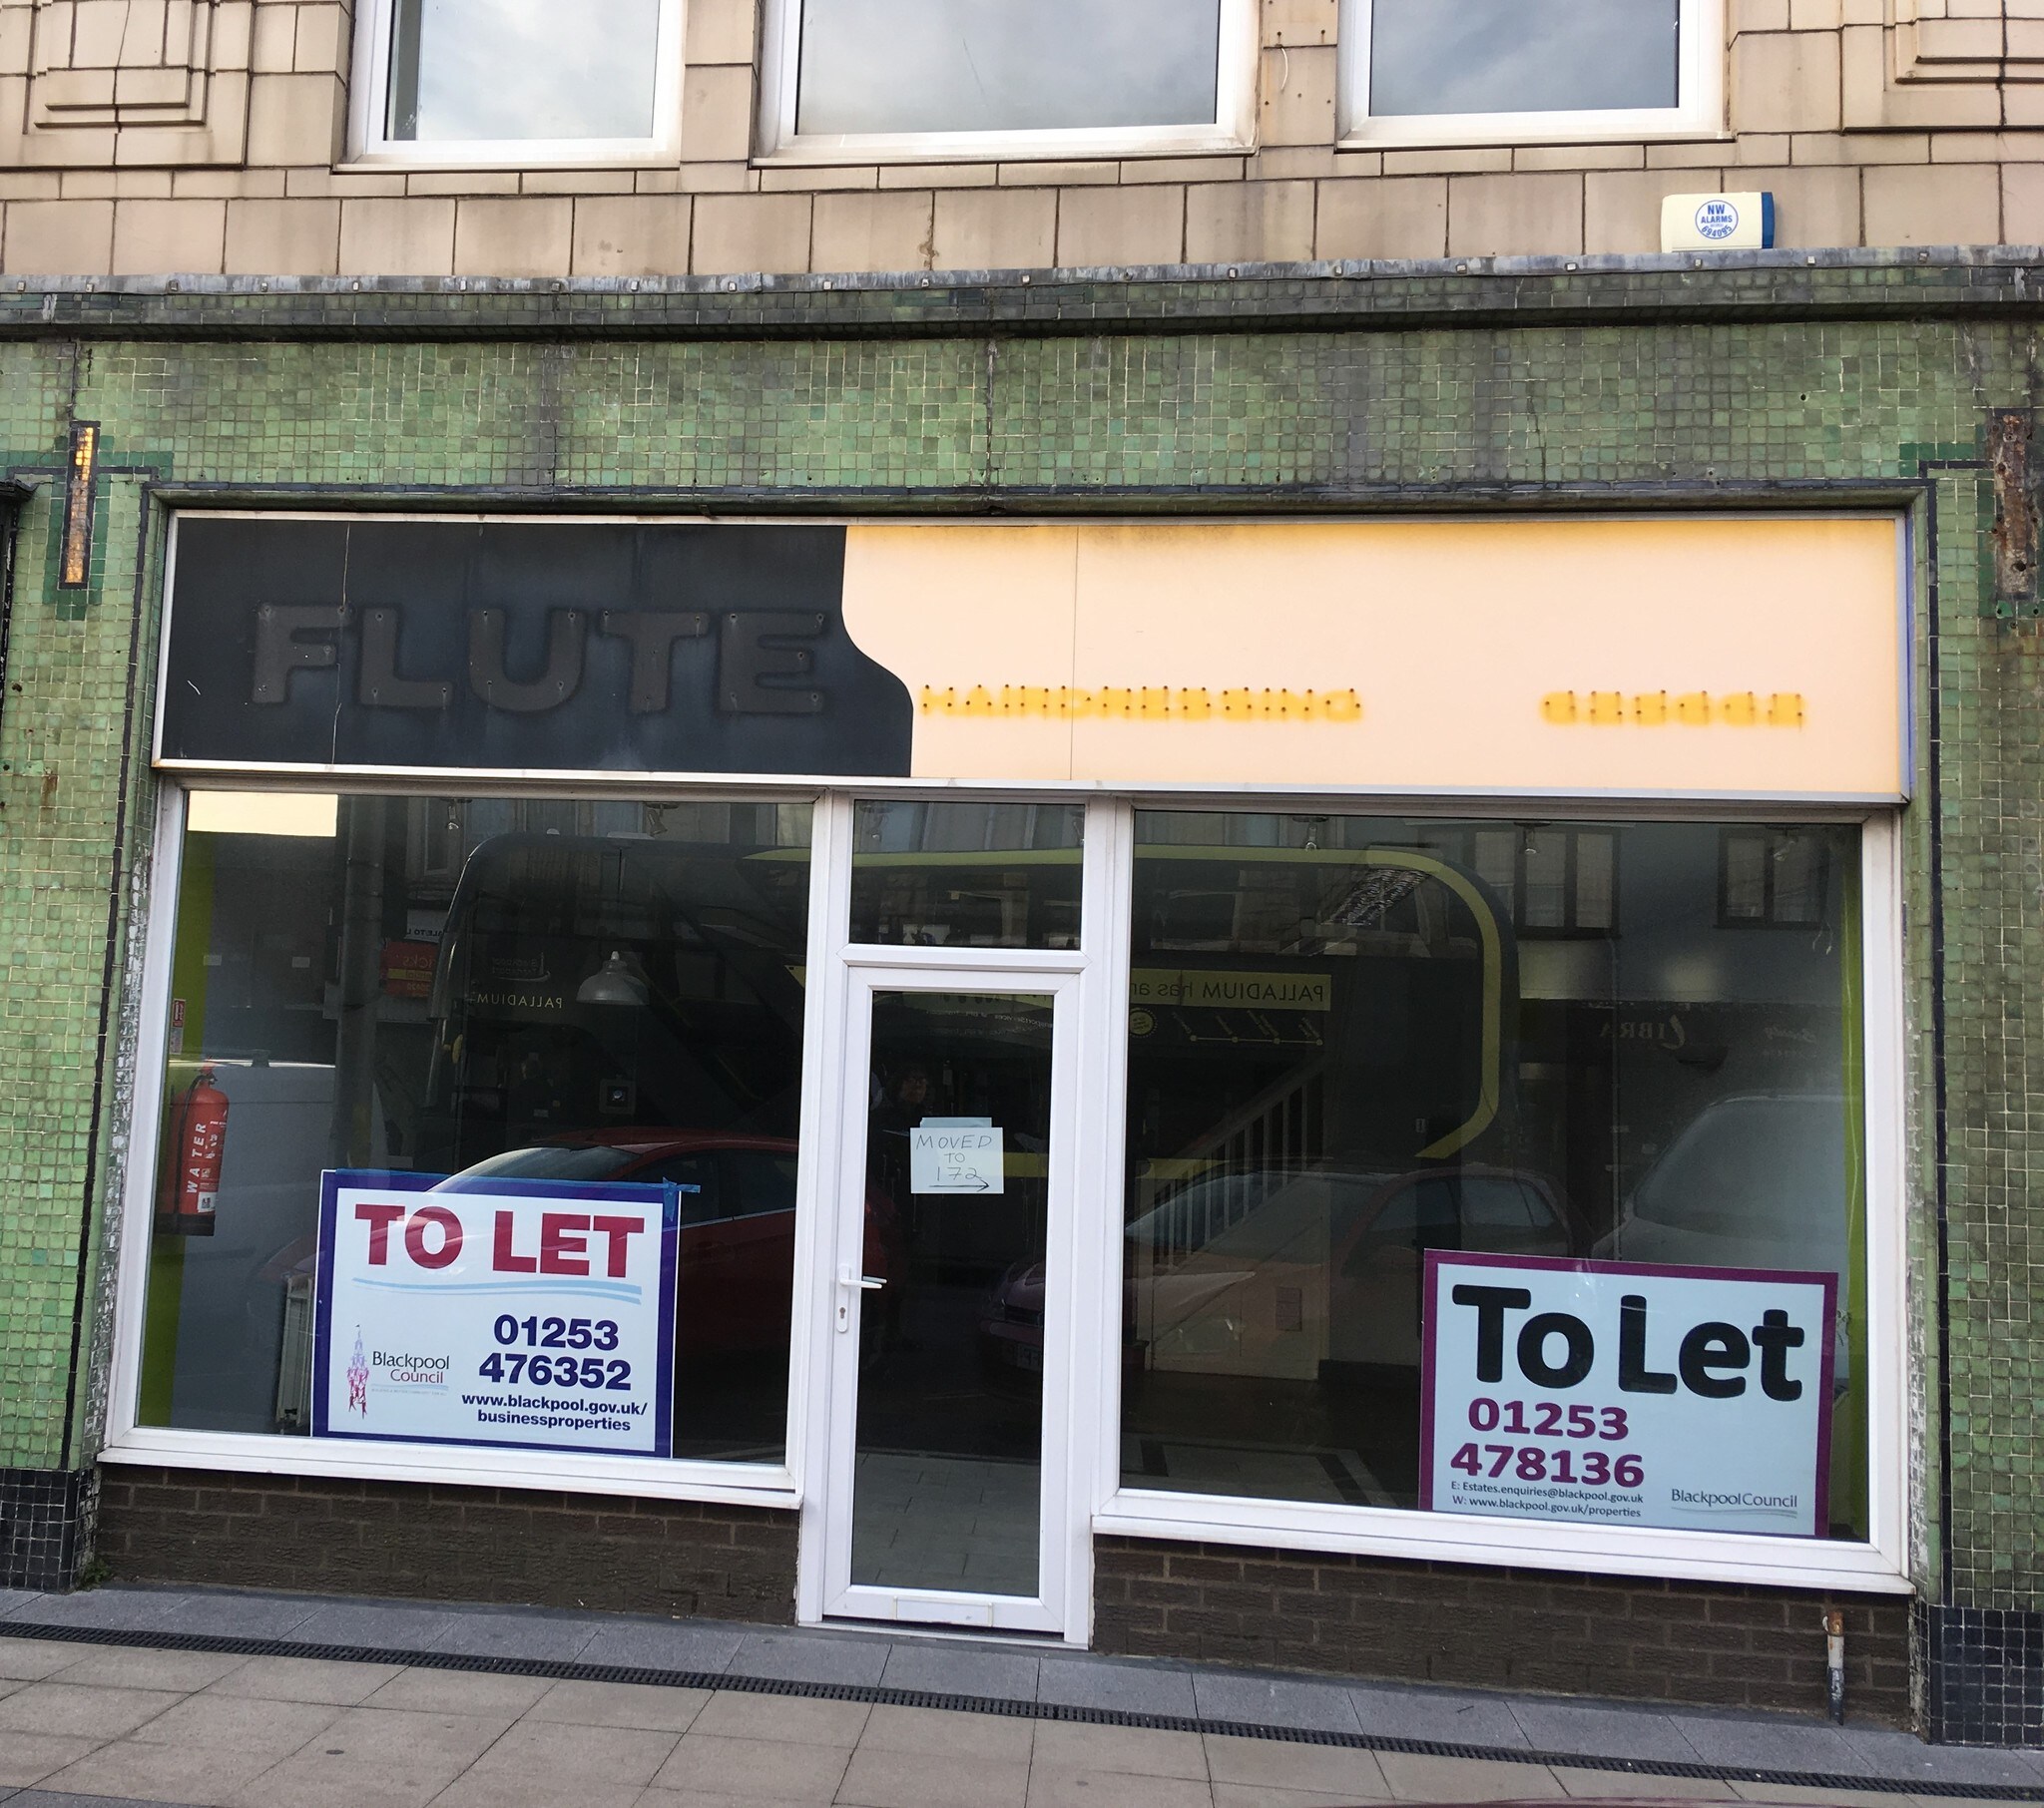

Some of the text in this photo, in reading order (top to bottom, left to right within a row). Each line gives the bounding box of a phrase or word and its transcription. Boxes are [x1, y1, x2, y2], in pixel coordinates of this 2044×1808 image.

[1701, 215, 1733, 224] ALARMS
[1707, 204, 1726, 216] NW
[252, 604, 827, 716] FLUTE
[915, 1133, 992, 1149] MOVED
[186, 1123, 207, 1194] WATER
[943, 1152, 965, 1163] TO
[936, 1166, 982, 1181] 172
[354, 1203, 645, 1278] TO LET
[494, 1313, 619, 1350] 01253
[1452, 1283, 1805, 1401] To Let
[371, 1350, 450, 1375] Blackpool
[479, 1352, 631, 1391] 476352
[390, 1368, 444, 1384] Council
[462, 1392, 647, 1416] www.blackpool.gov.uk/
[477, 1409, 631, 1432] businessproperties
[1468, 1397, 1629, 1441] 01253
[1450, 1442, 1645, 1488] 478136
[1451, 1481, 1644, 1505] E: Estates.enquiries@blackpool.gov.uk
[1452, 1496, 1642, 1519] W: www.blackpool.gov.uk/properties
